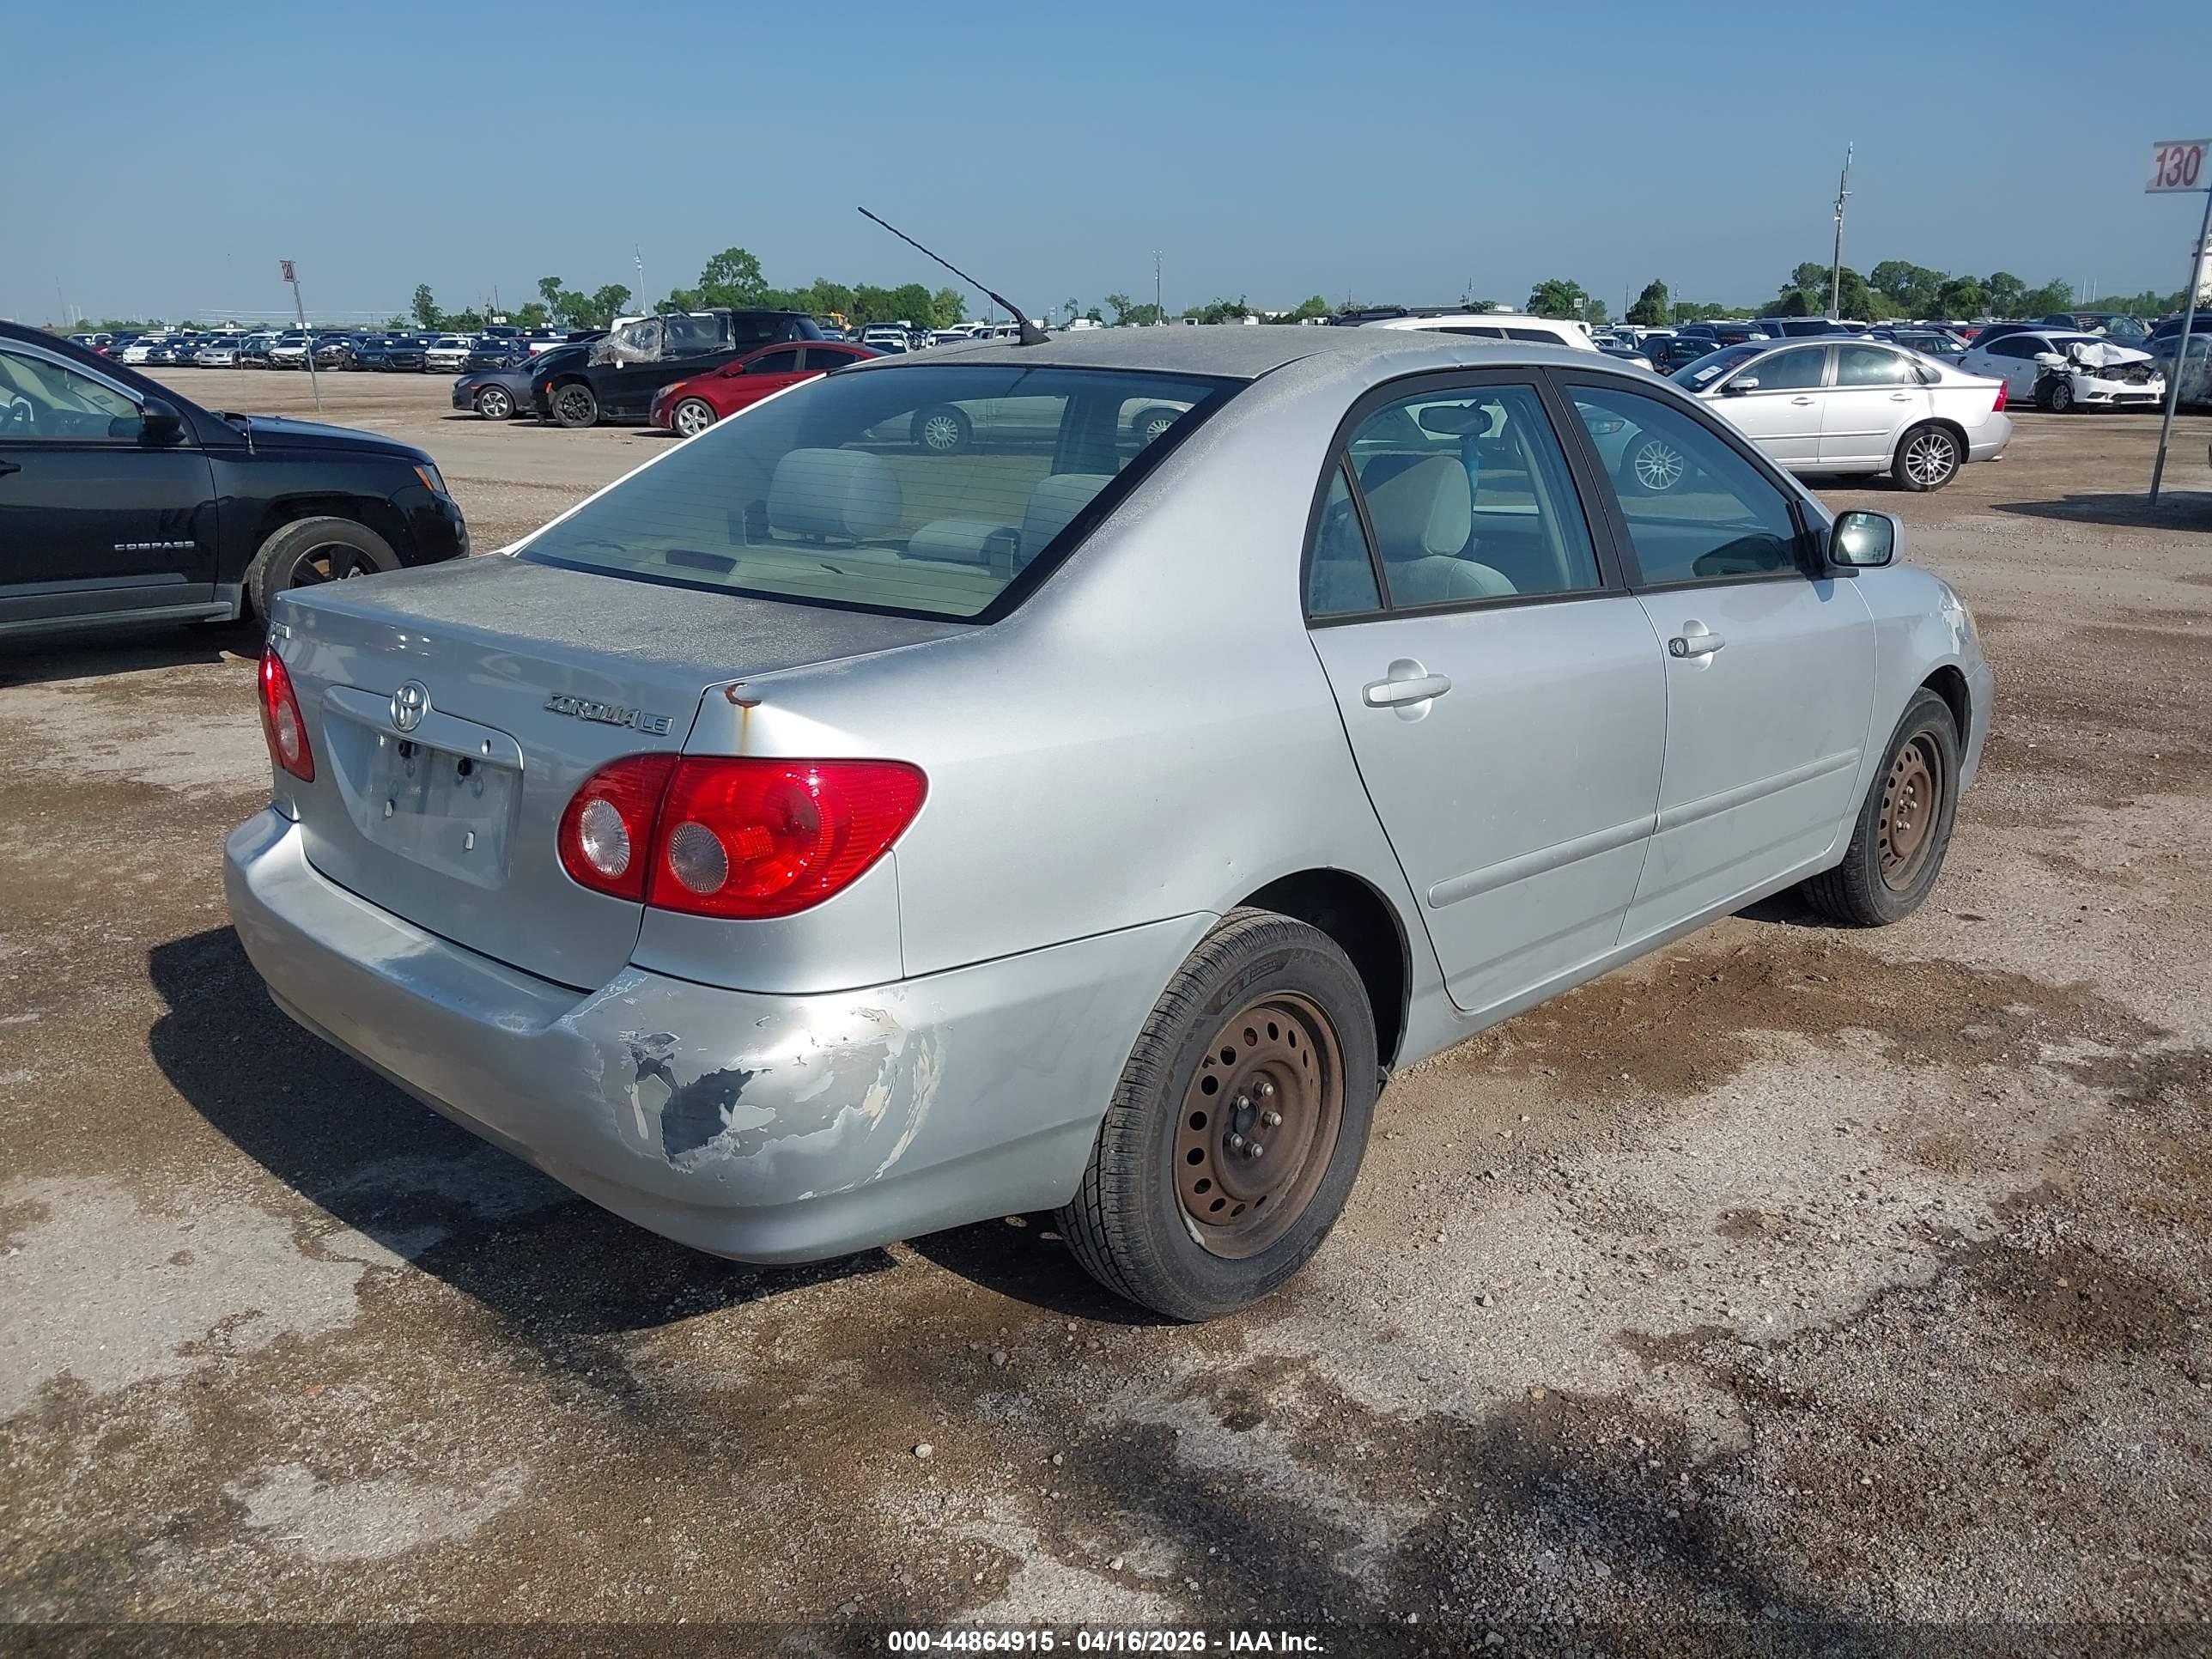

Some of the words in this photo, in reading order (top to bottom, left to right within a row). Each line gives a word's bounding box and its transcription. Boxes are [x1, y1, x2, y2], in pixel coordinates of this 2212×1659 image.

[2156, 145, 2201, 187] 130
[114, 541, 195, 550] COMPASS
[544, 693, 641, 729] COROLLA
[642, 713, 670, 734] LE
